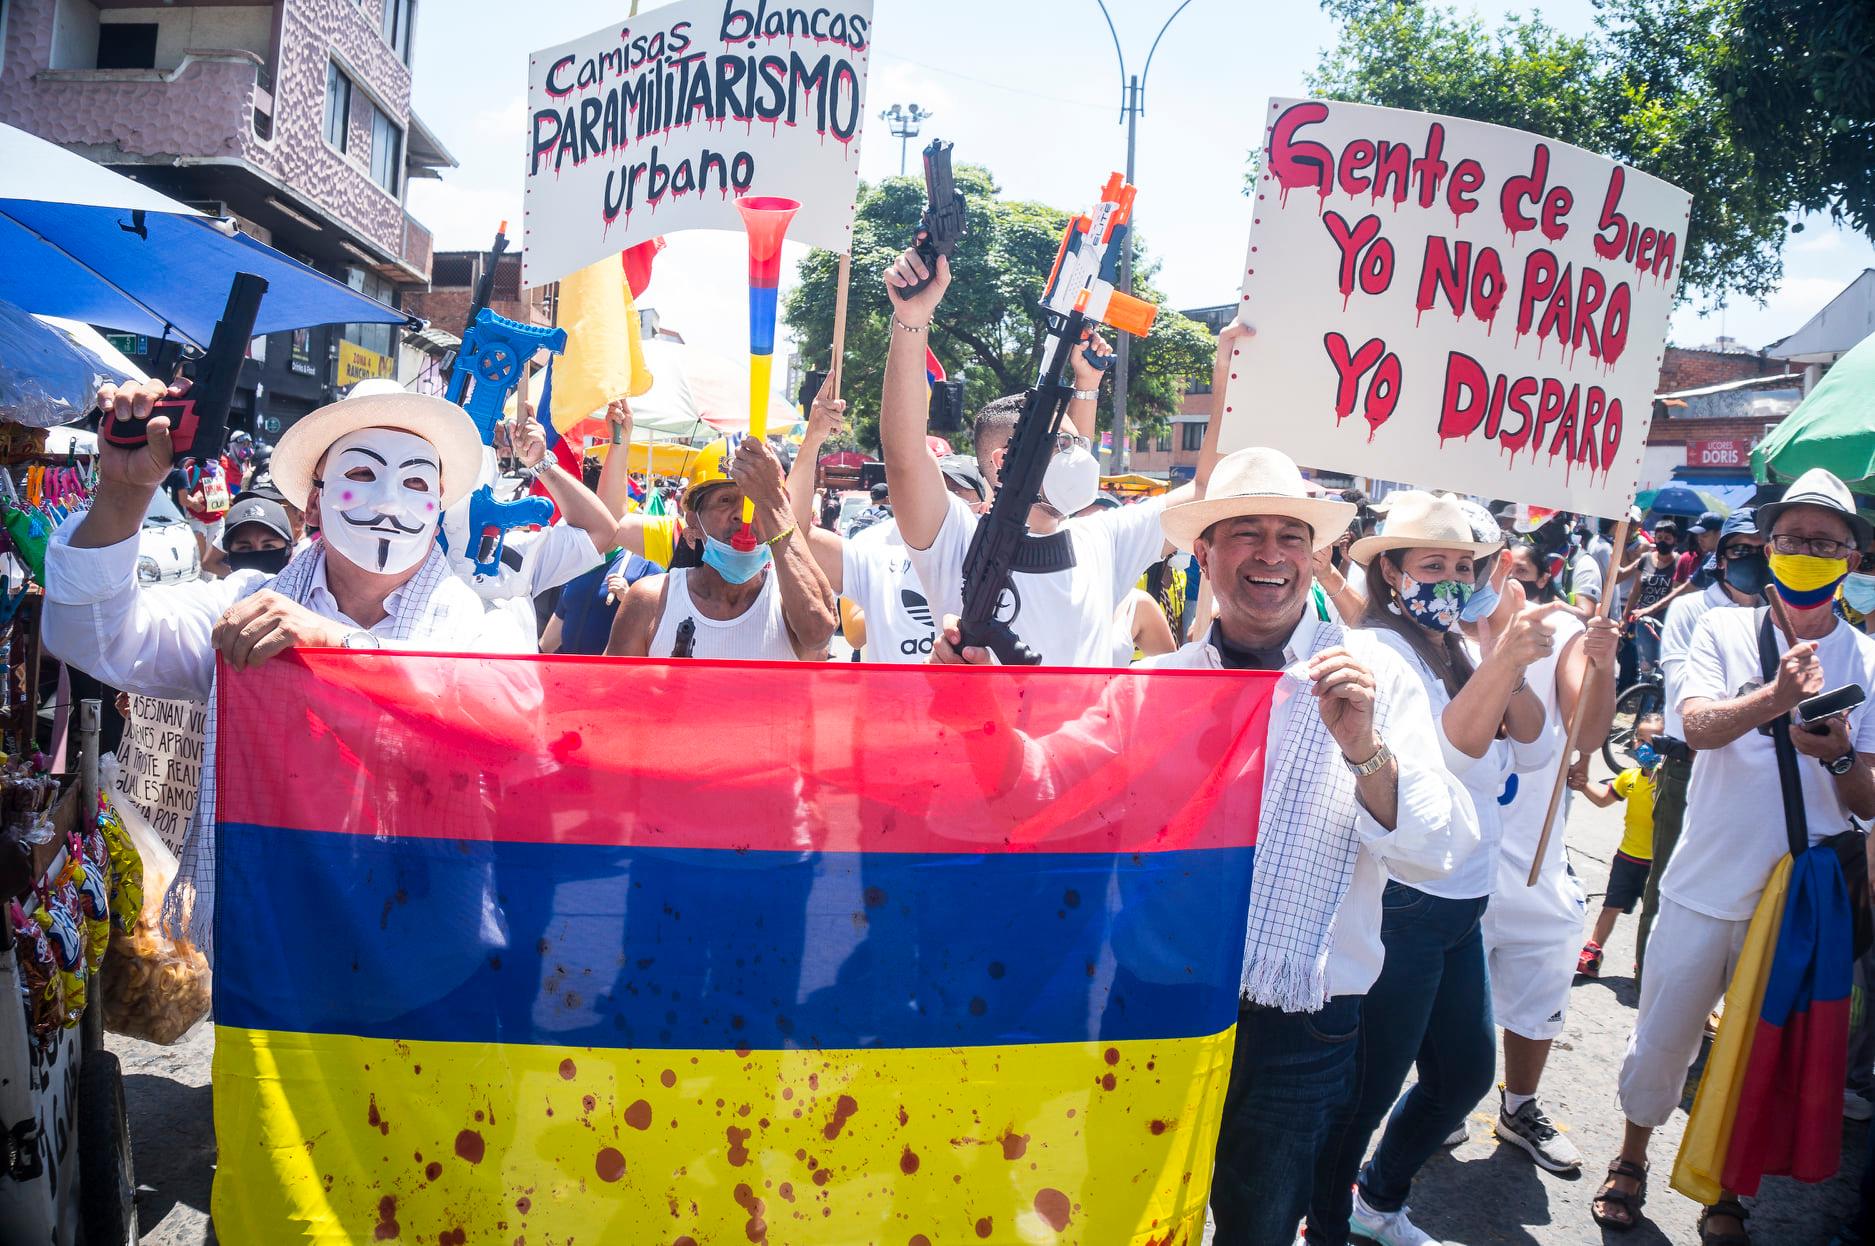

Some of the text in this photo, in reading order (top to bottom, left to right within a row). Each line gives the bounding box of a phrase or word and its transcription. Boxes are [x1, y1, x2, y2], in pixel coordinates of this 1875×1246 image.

[545, 0, 867, 96] Camisas blancas
[603, 146, 755, 222] urbano
[1268, 102, 1677, 281] Gente de bien
[1416, 235, 1507, 324] NO
[1516, 249, 1632, 365] PARO
[1438, 351, 1624, 473] DISPARO
[1702, 450, 1738, 463] DORIS
[117, 741, 130, 766] LA
[153, 809, 179, 835] POR
